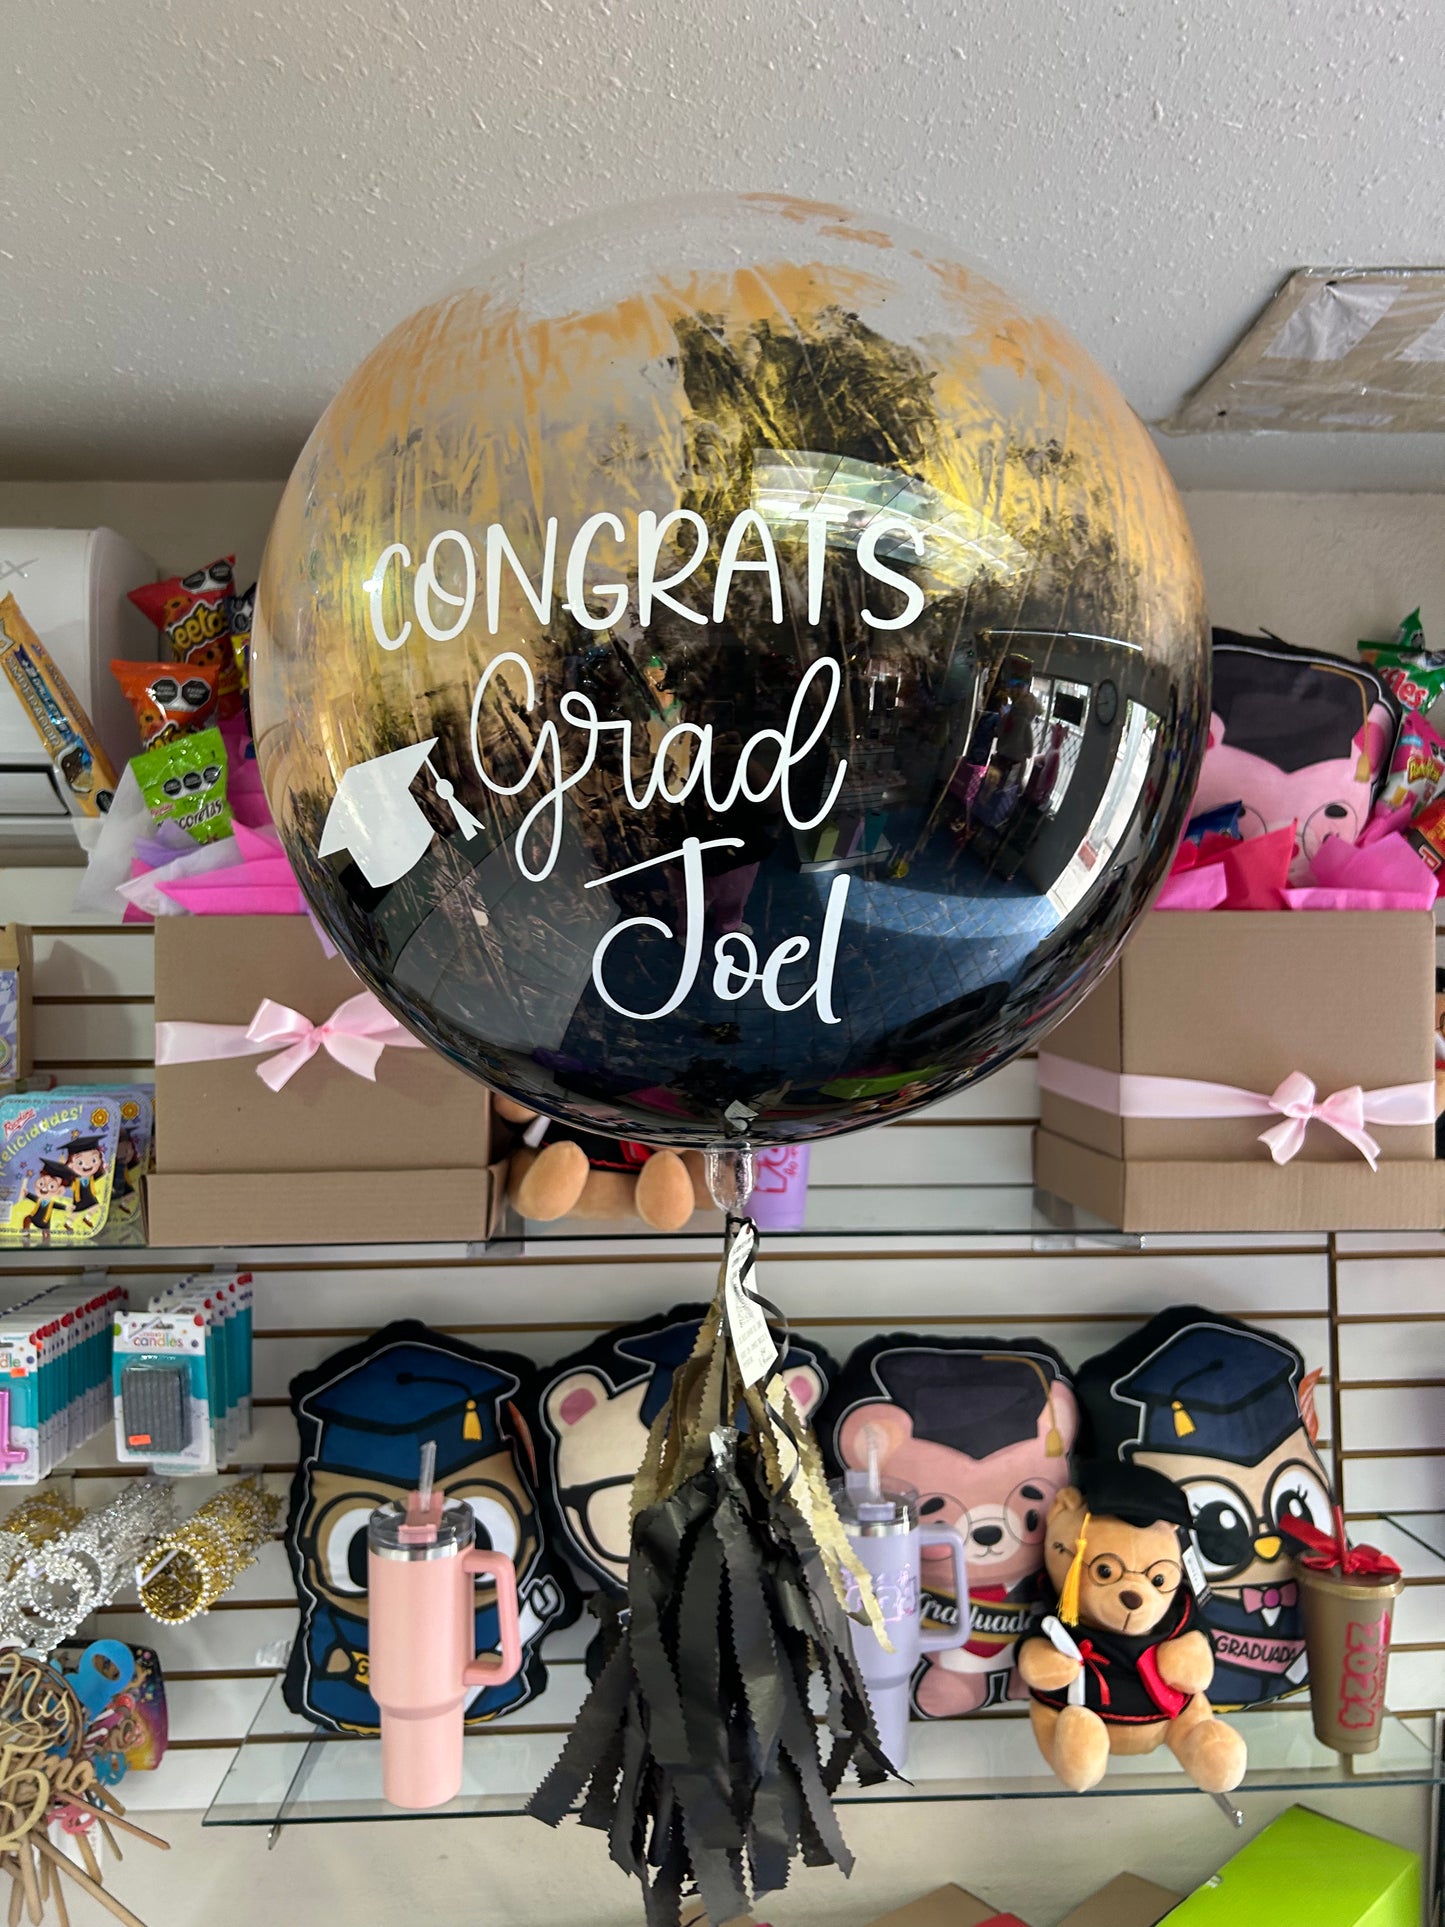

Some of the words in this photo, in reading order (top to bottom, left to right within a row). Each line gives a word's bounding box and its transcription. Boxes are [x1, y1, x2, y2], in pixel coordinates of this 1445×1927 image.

[363, 508, 926, 651] CONGRATS
[157, 799, 222, 831] coretas
[470, 651, 848, 882] Grad
[584, 836, 851, 1025] Joel
[133, 1331, 184, 1348] candles
[1338, 1620, 1380, 1730] 2024
